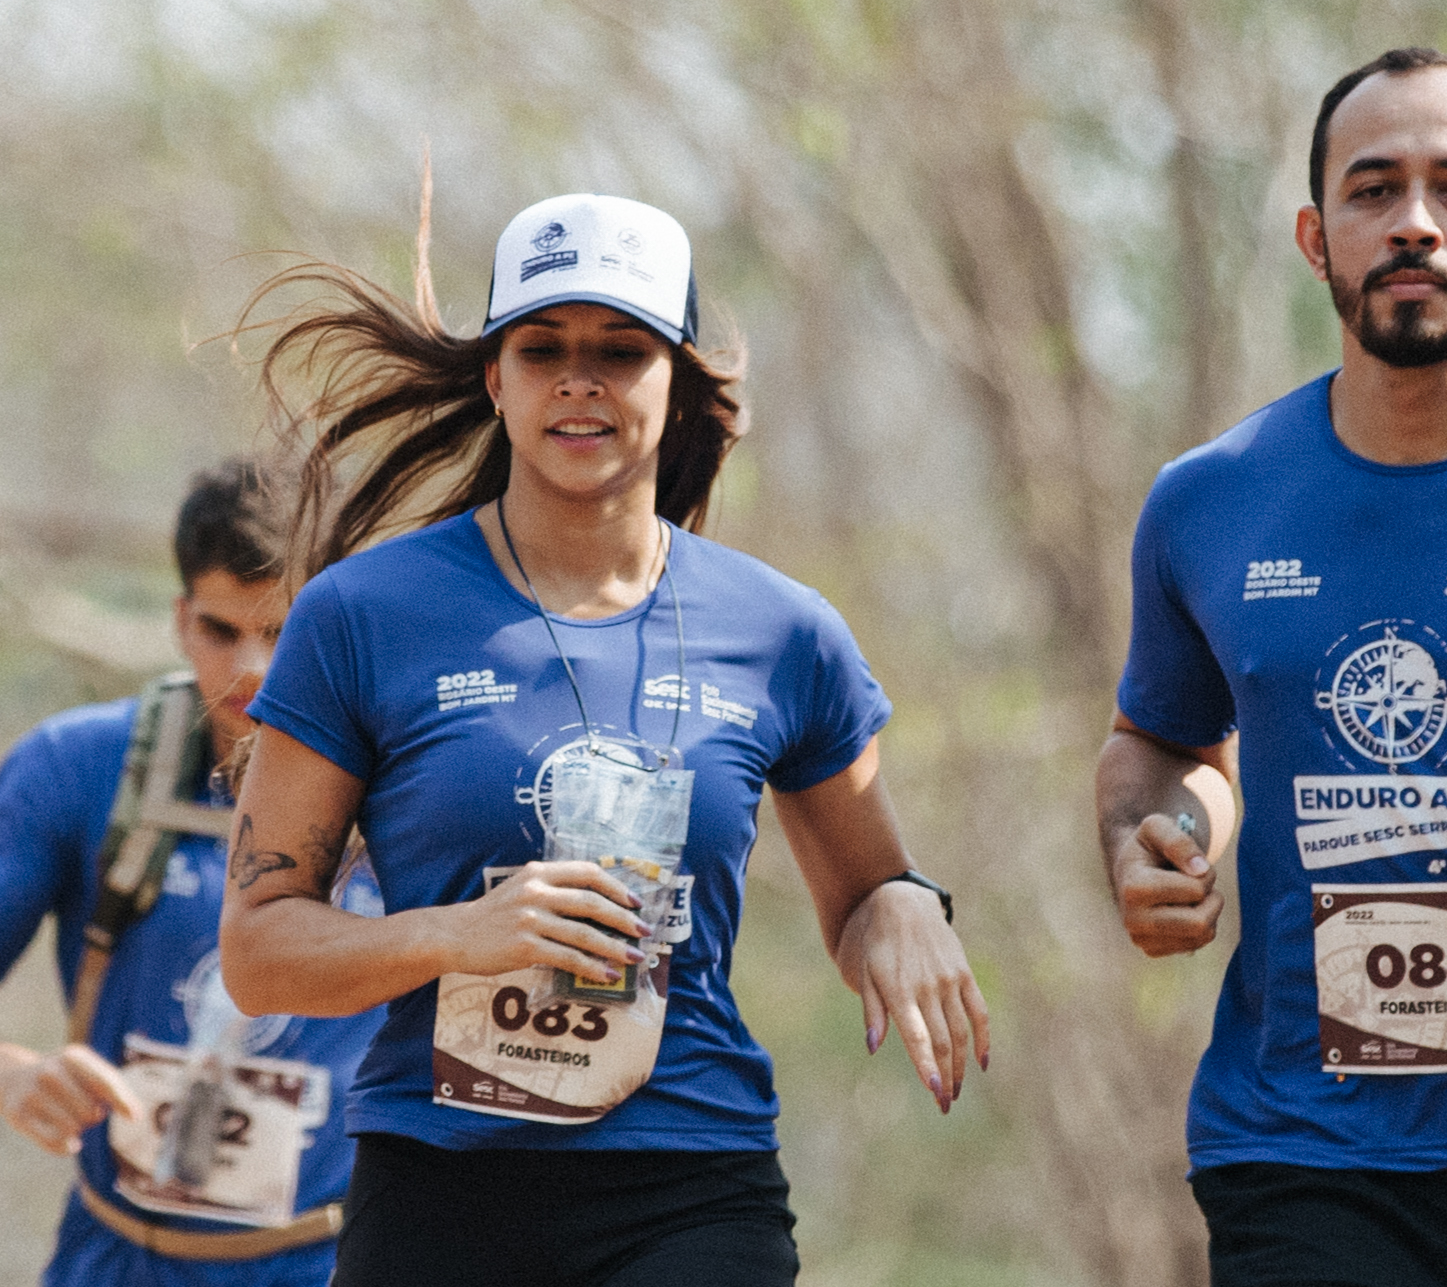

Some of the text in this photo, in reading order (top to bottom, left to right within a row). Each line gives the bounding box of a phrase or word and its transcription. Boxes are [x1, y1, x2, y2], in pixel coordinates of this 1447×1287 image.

[1246, 559, 1302, 579] 2022
[436, 669, 496, 691] 2022
[1300, 787, 1421, 809] ENDURO
[1304, 834, 1360, 853] PARQUE
[1363, 826, 1405, 843] SESC
[1346, 910, 1374, 920] 2022
[492, 986, 609, 1042] 083
[498, 1043, 591, 1067] FORASTEIROS
